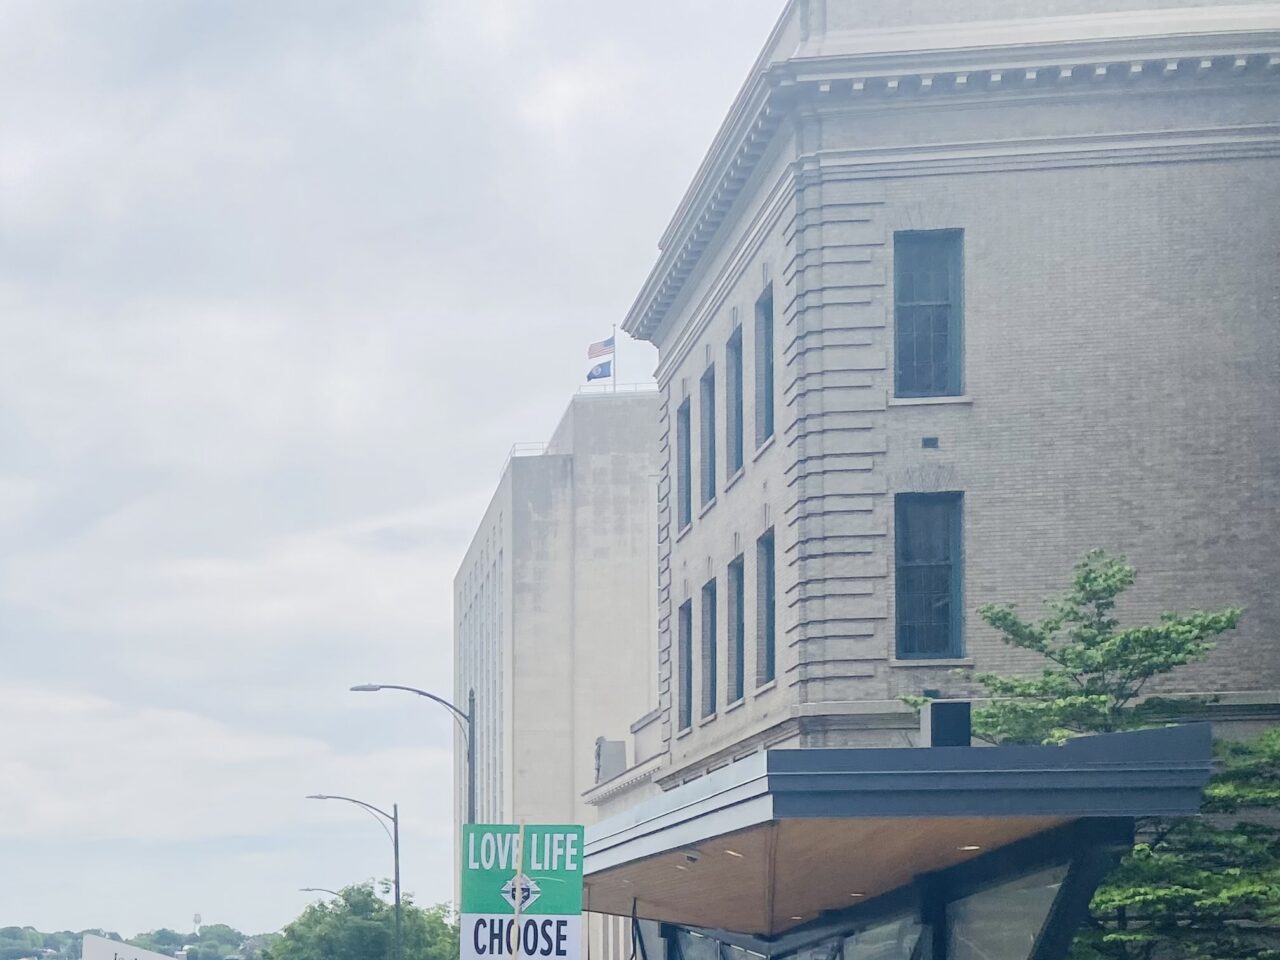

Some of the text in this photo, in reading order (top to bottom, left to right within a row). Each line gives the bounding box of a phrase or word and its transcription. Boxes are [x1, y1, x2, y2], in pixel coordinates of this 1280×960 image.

[468, 832, 578, 870] LOVE LIFE
[473, 918, 568, 956] CHOOSE
